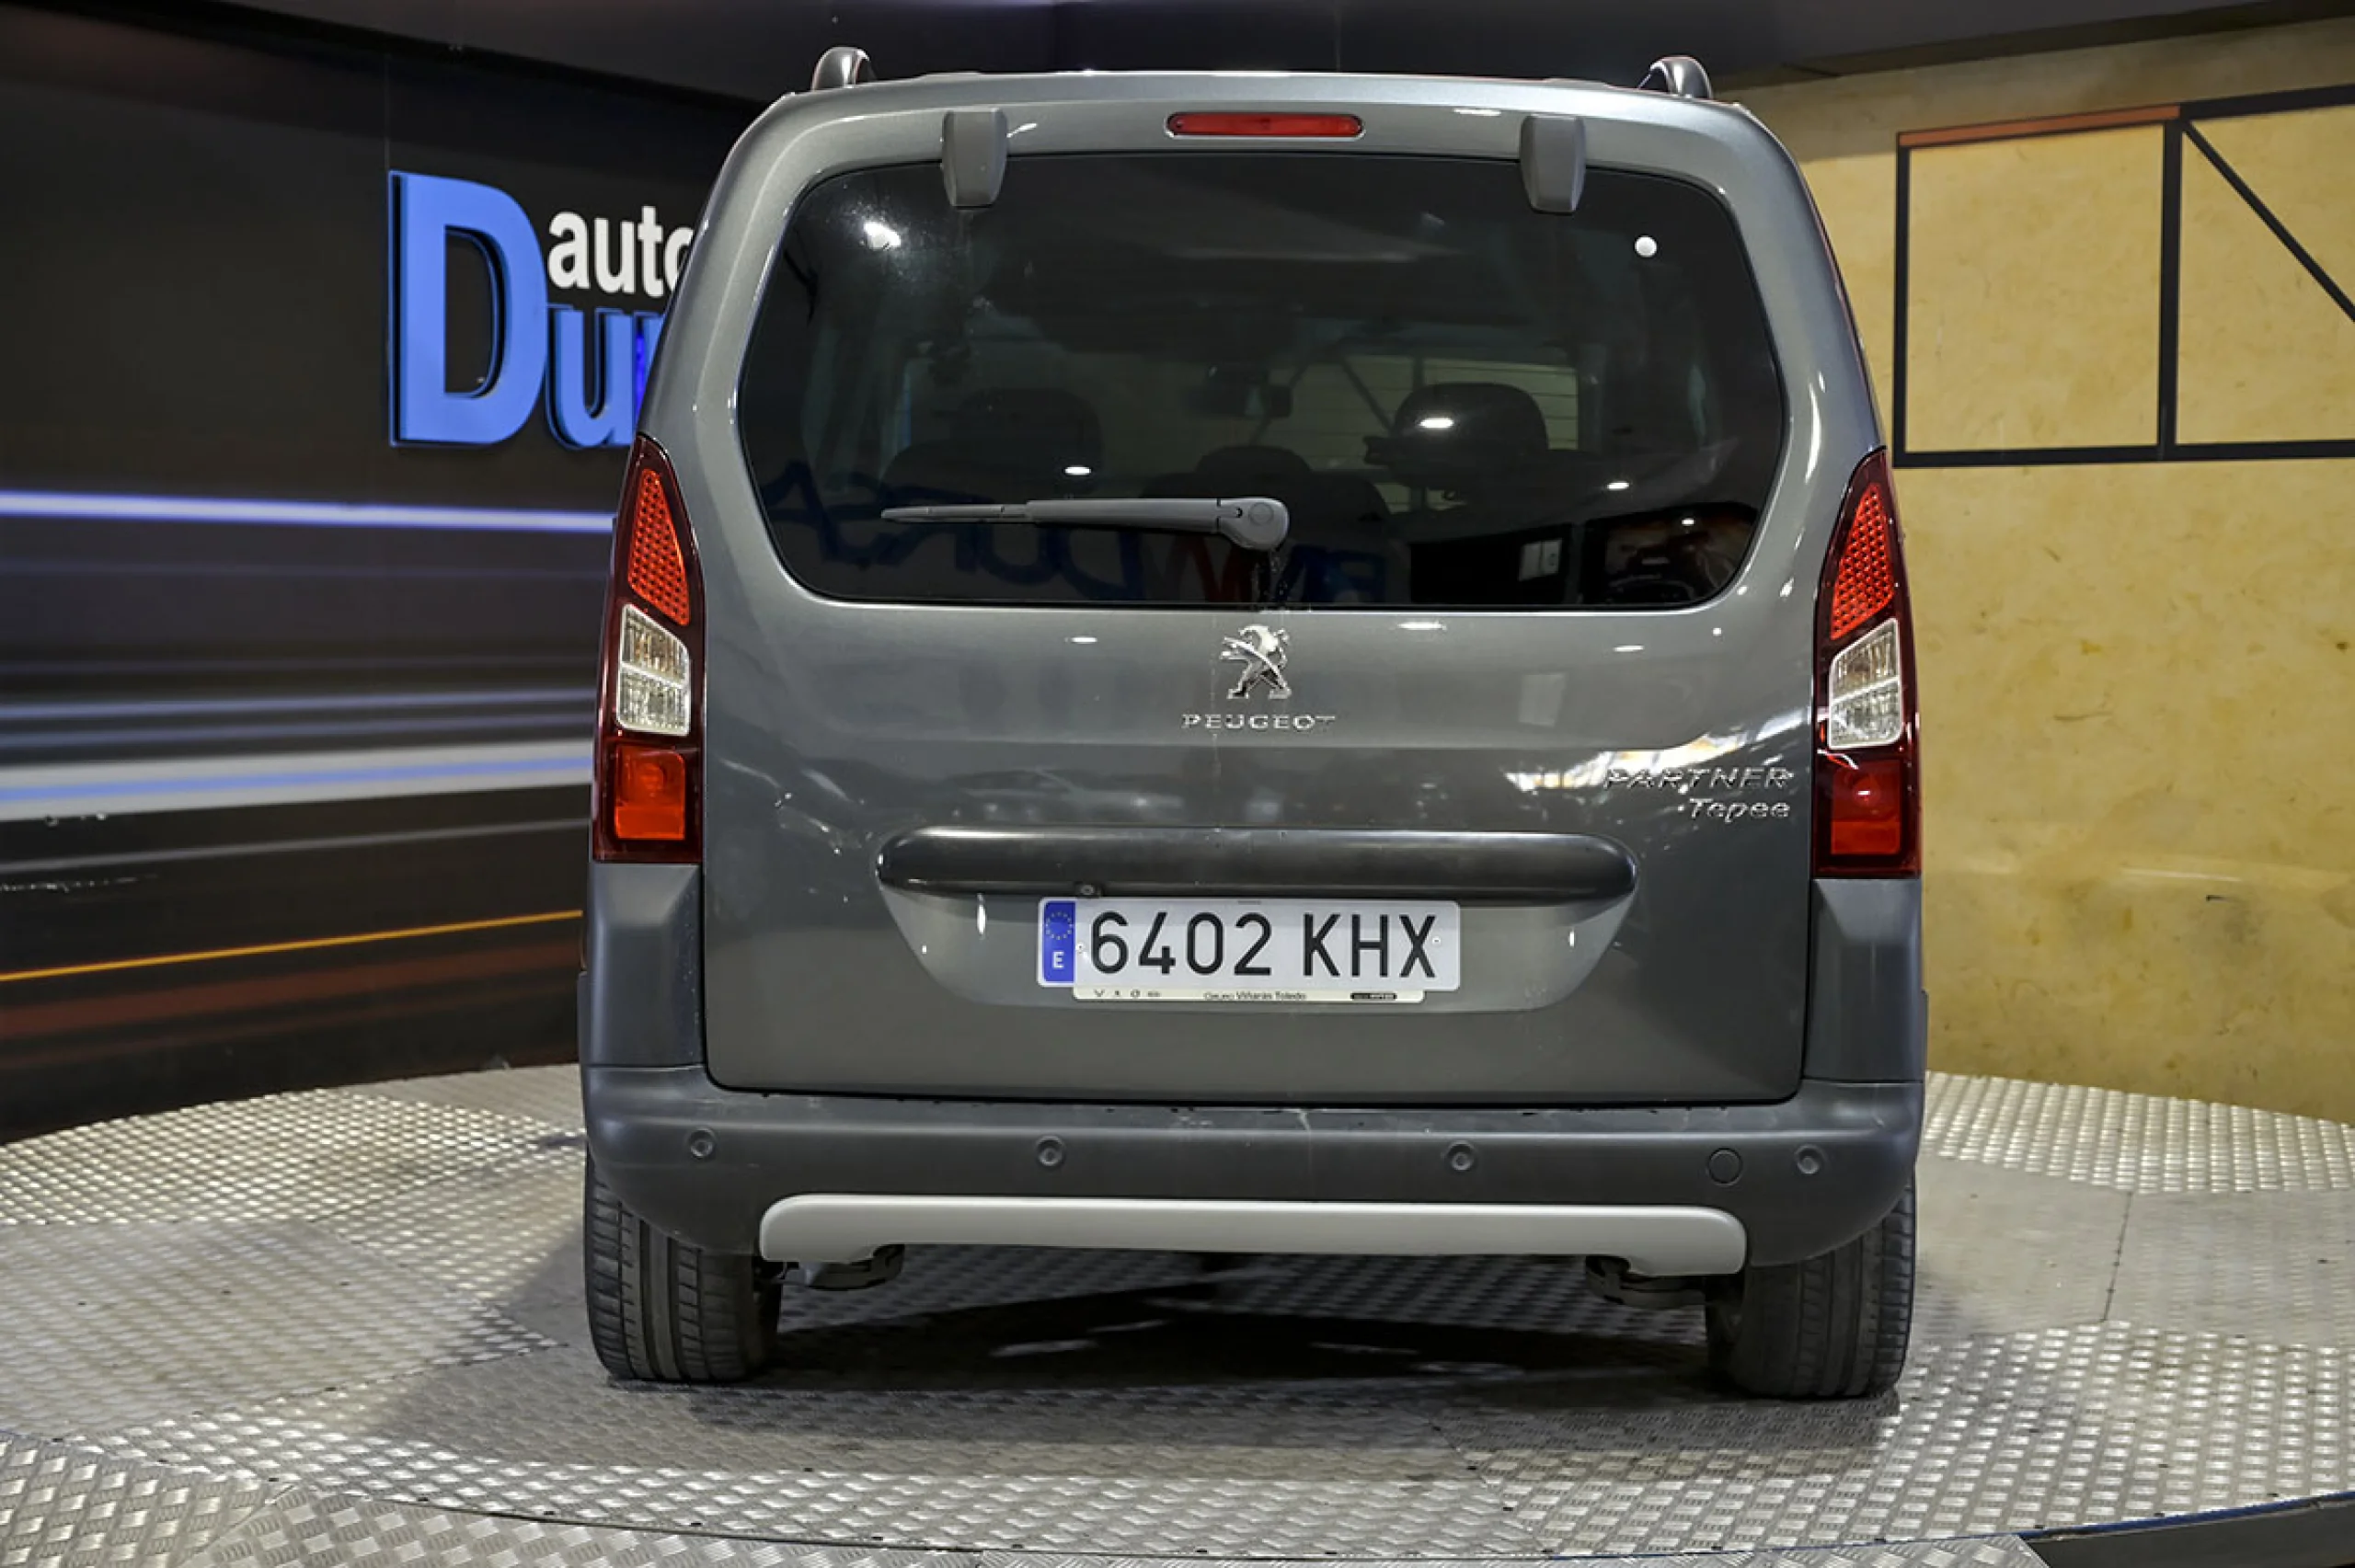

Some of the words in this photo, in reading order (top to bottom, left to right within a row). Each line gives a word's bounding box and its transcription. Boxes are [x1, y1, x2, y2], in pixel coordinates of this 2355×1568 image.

[1181, 714, 1336, 729] PEUGEOT
[1603, 767, 1794, 789] PARTNER
[1689, 797, 1791, 823] Tepee
[1091, 910, 1272, 975] 6402
[1302, 912, 1437, 979] KHX
[1052, 951, 1064, 969] E
